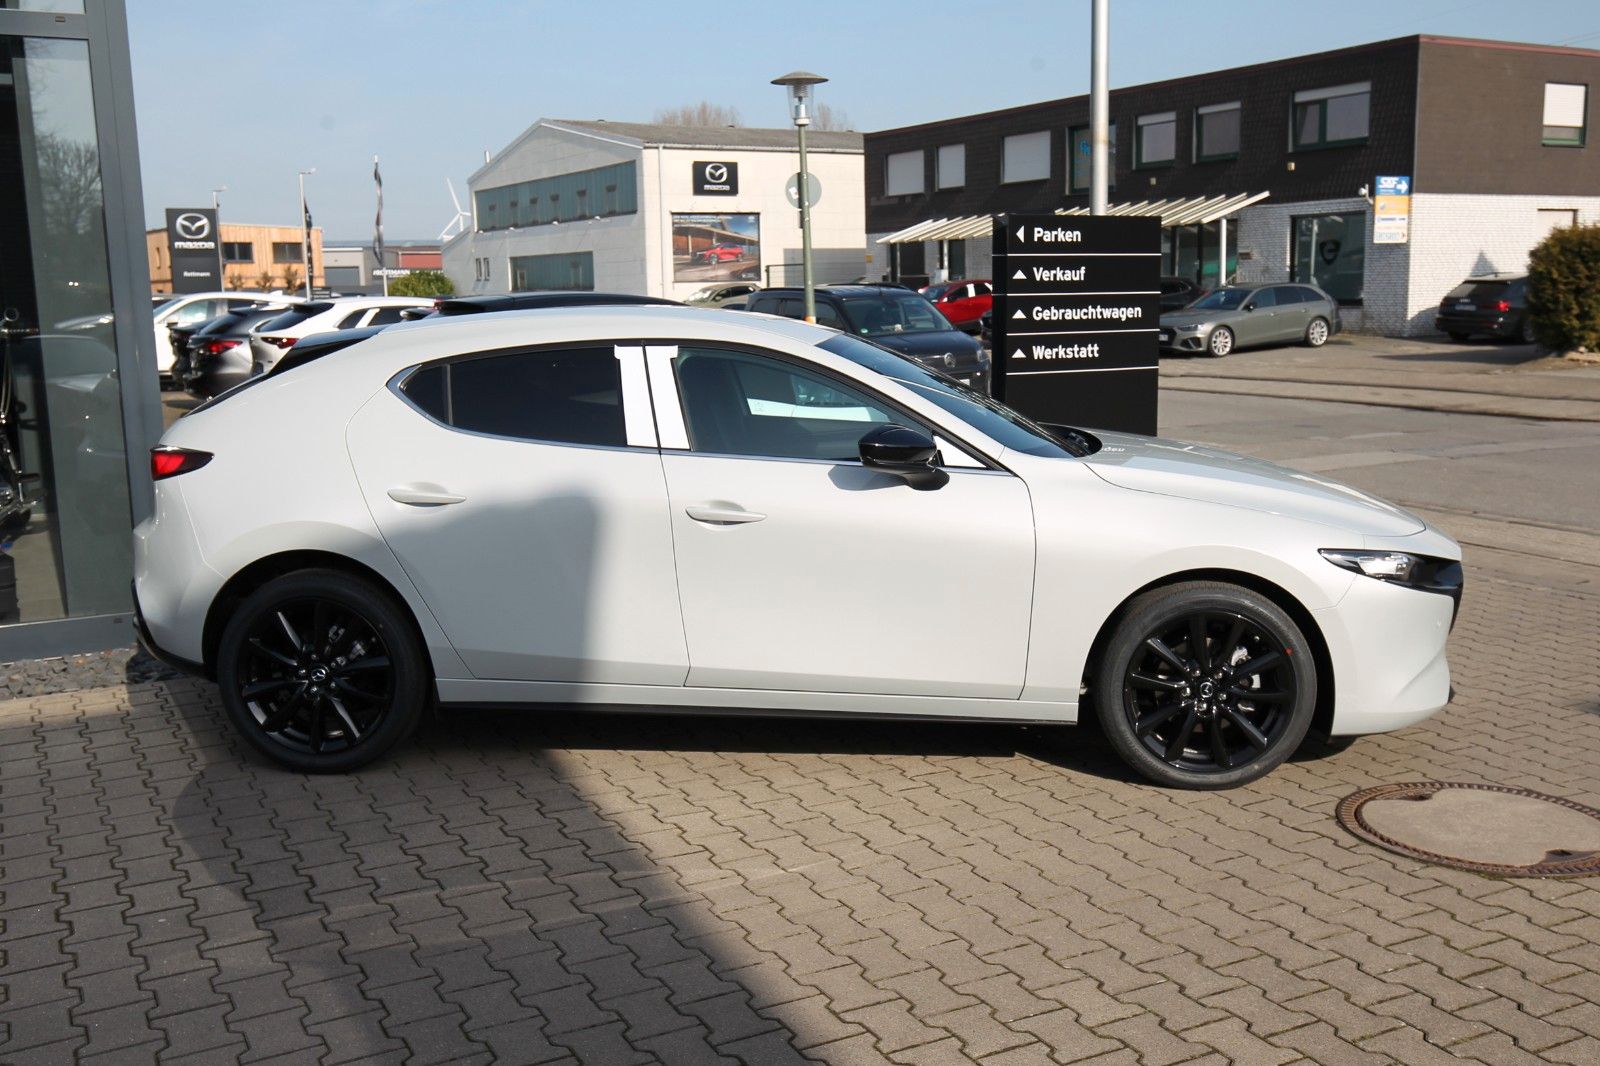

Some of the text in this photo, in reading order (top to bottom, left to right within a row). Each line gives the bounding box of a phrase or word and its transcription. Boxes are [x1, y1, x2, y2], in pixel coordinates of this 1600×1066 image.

[1033, 227, 1082, 242] Parken
[1032, 266, 1086, 281] Verkauf
[1032, 305, 1142, 321] Gebrauchtwagen
[1032, 343, 1099, 359] Werkstatt
